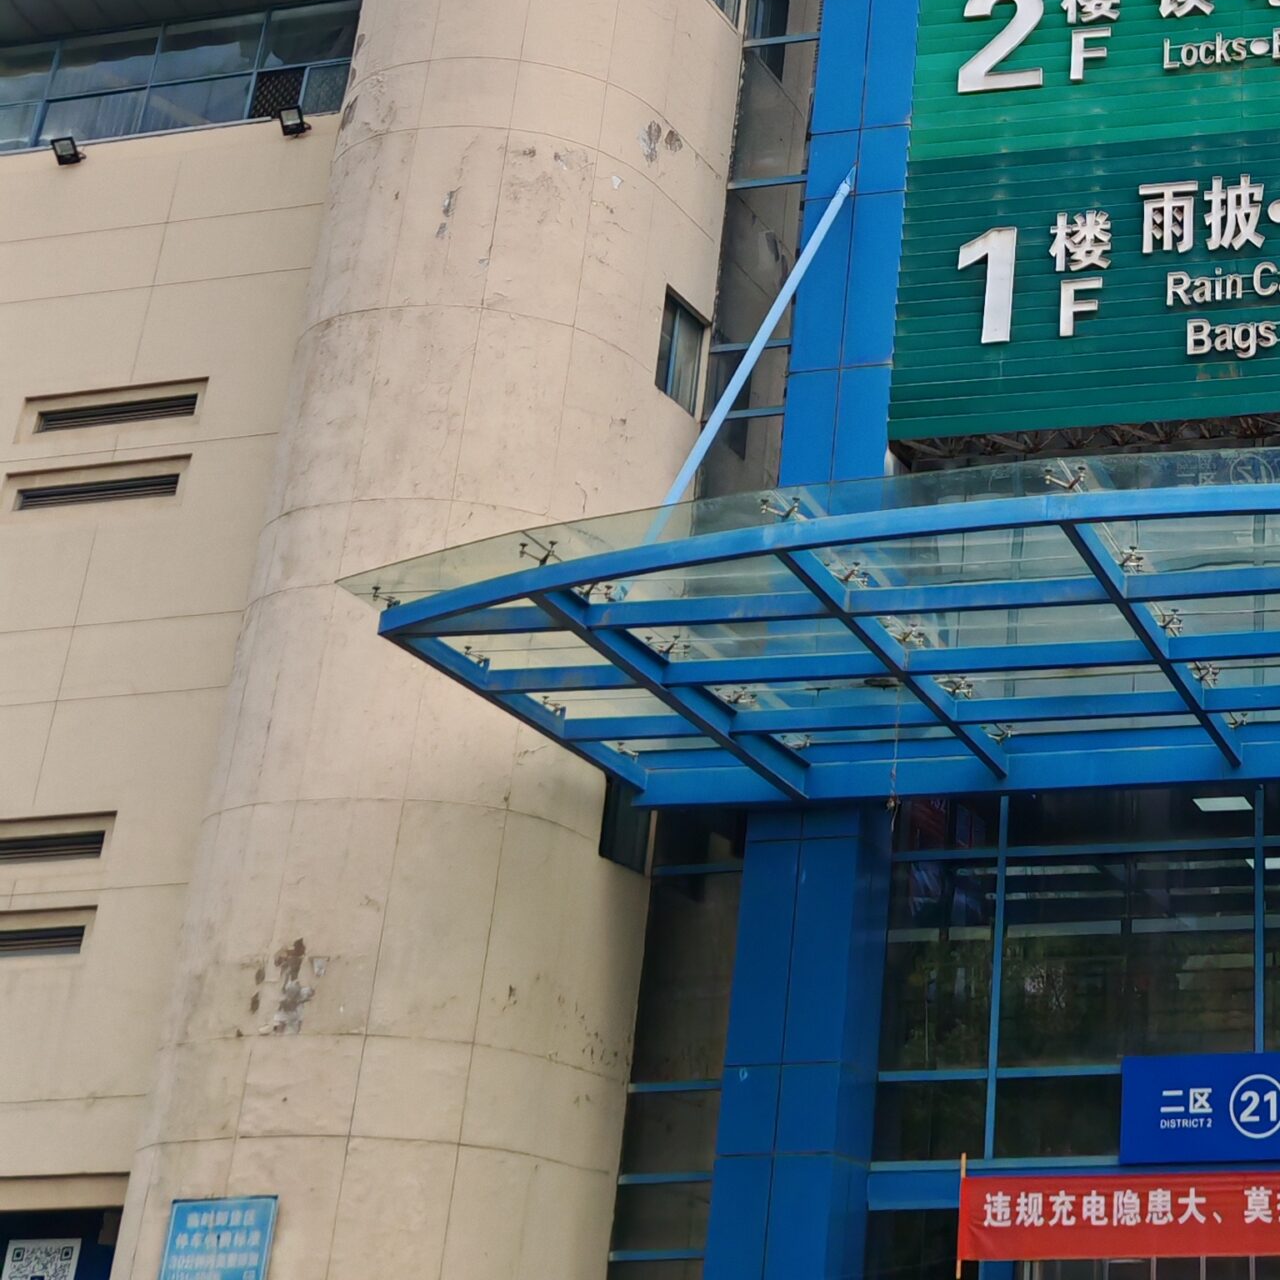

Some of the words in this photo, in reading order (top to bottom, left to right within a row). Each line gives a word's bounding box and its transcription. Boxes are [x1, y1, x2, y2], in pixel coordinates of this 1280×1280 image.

[1070, 27, 1111, 82] F
[1049, 210, 1112, 273] 楼
[957, 226, 1018, 344] 1
[1059, 276, 1103, 337] F
[1166, 268, 1243, 306] Rain
[1160, 1087, 1213, 1114] 二区
[1239, 1090, 1278, 1122] 21
